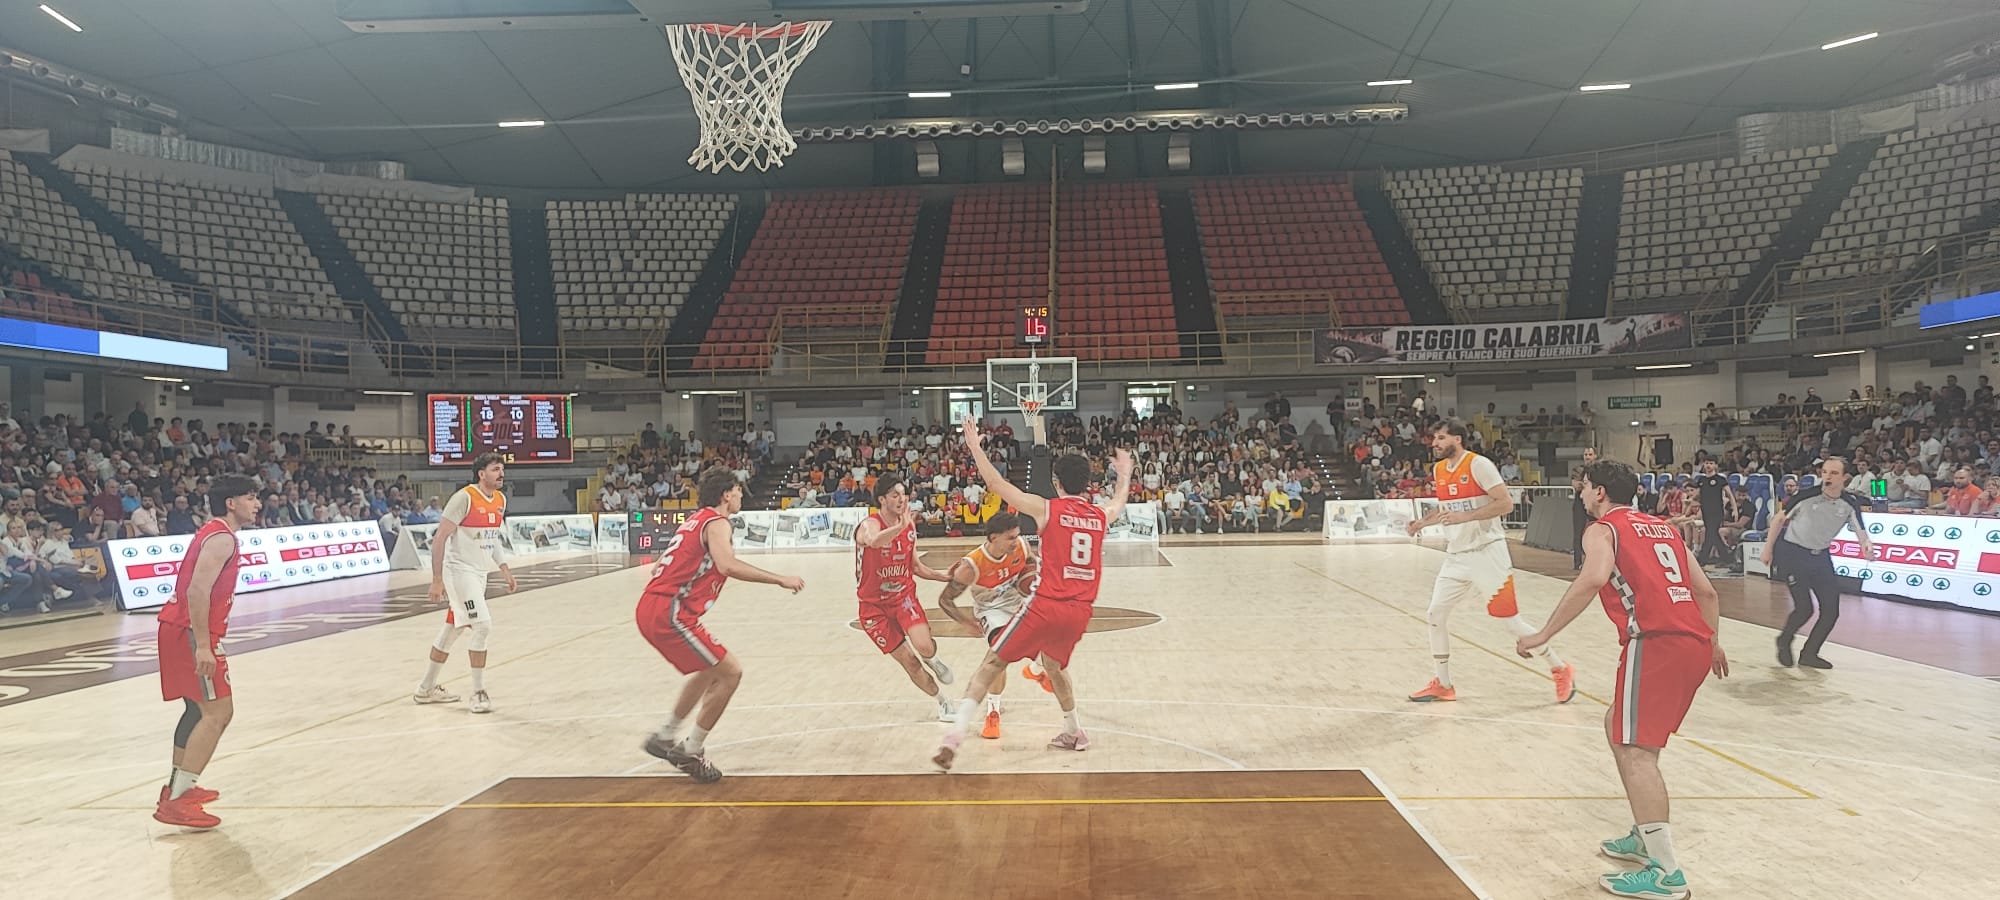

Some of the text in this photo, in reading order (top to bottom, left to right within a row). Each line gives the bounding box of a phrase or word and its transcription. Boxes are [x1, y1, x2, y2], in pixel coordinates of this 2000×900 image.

[1025, 308, 1047, 317] 4:15
[1027, 318, 1046, 335] 16
[1396, 322, 1600, 350] REGGIO CALABRIA
[1406, 345, 1592, 361] SEMPRE AL FIANCO DEI SUOI GUERRIERI
[480, 410, 493, 419] 18
[510, 410, 523, 419] 10
[653, 512, 685, 524] 4:15
[640, 536, 651, 547] 18
[1070, 532, 1093, 565] 8
[298, 541, 378, 559] DESPAR
[1653, 543, 1683, 583] 9
[464, 600, 475, 611] 10
